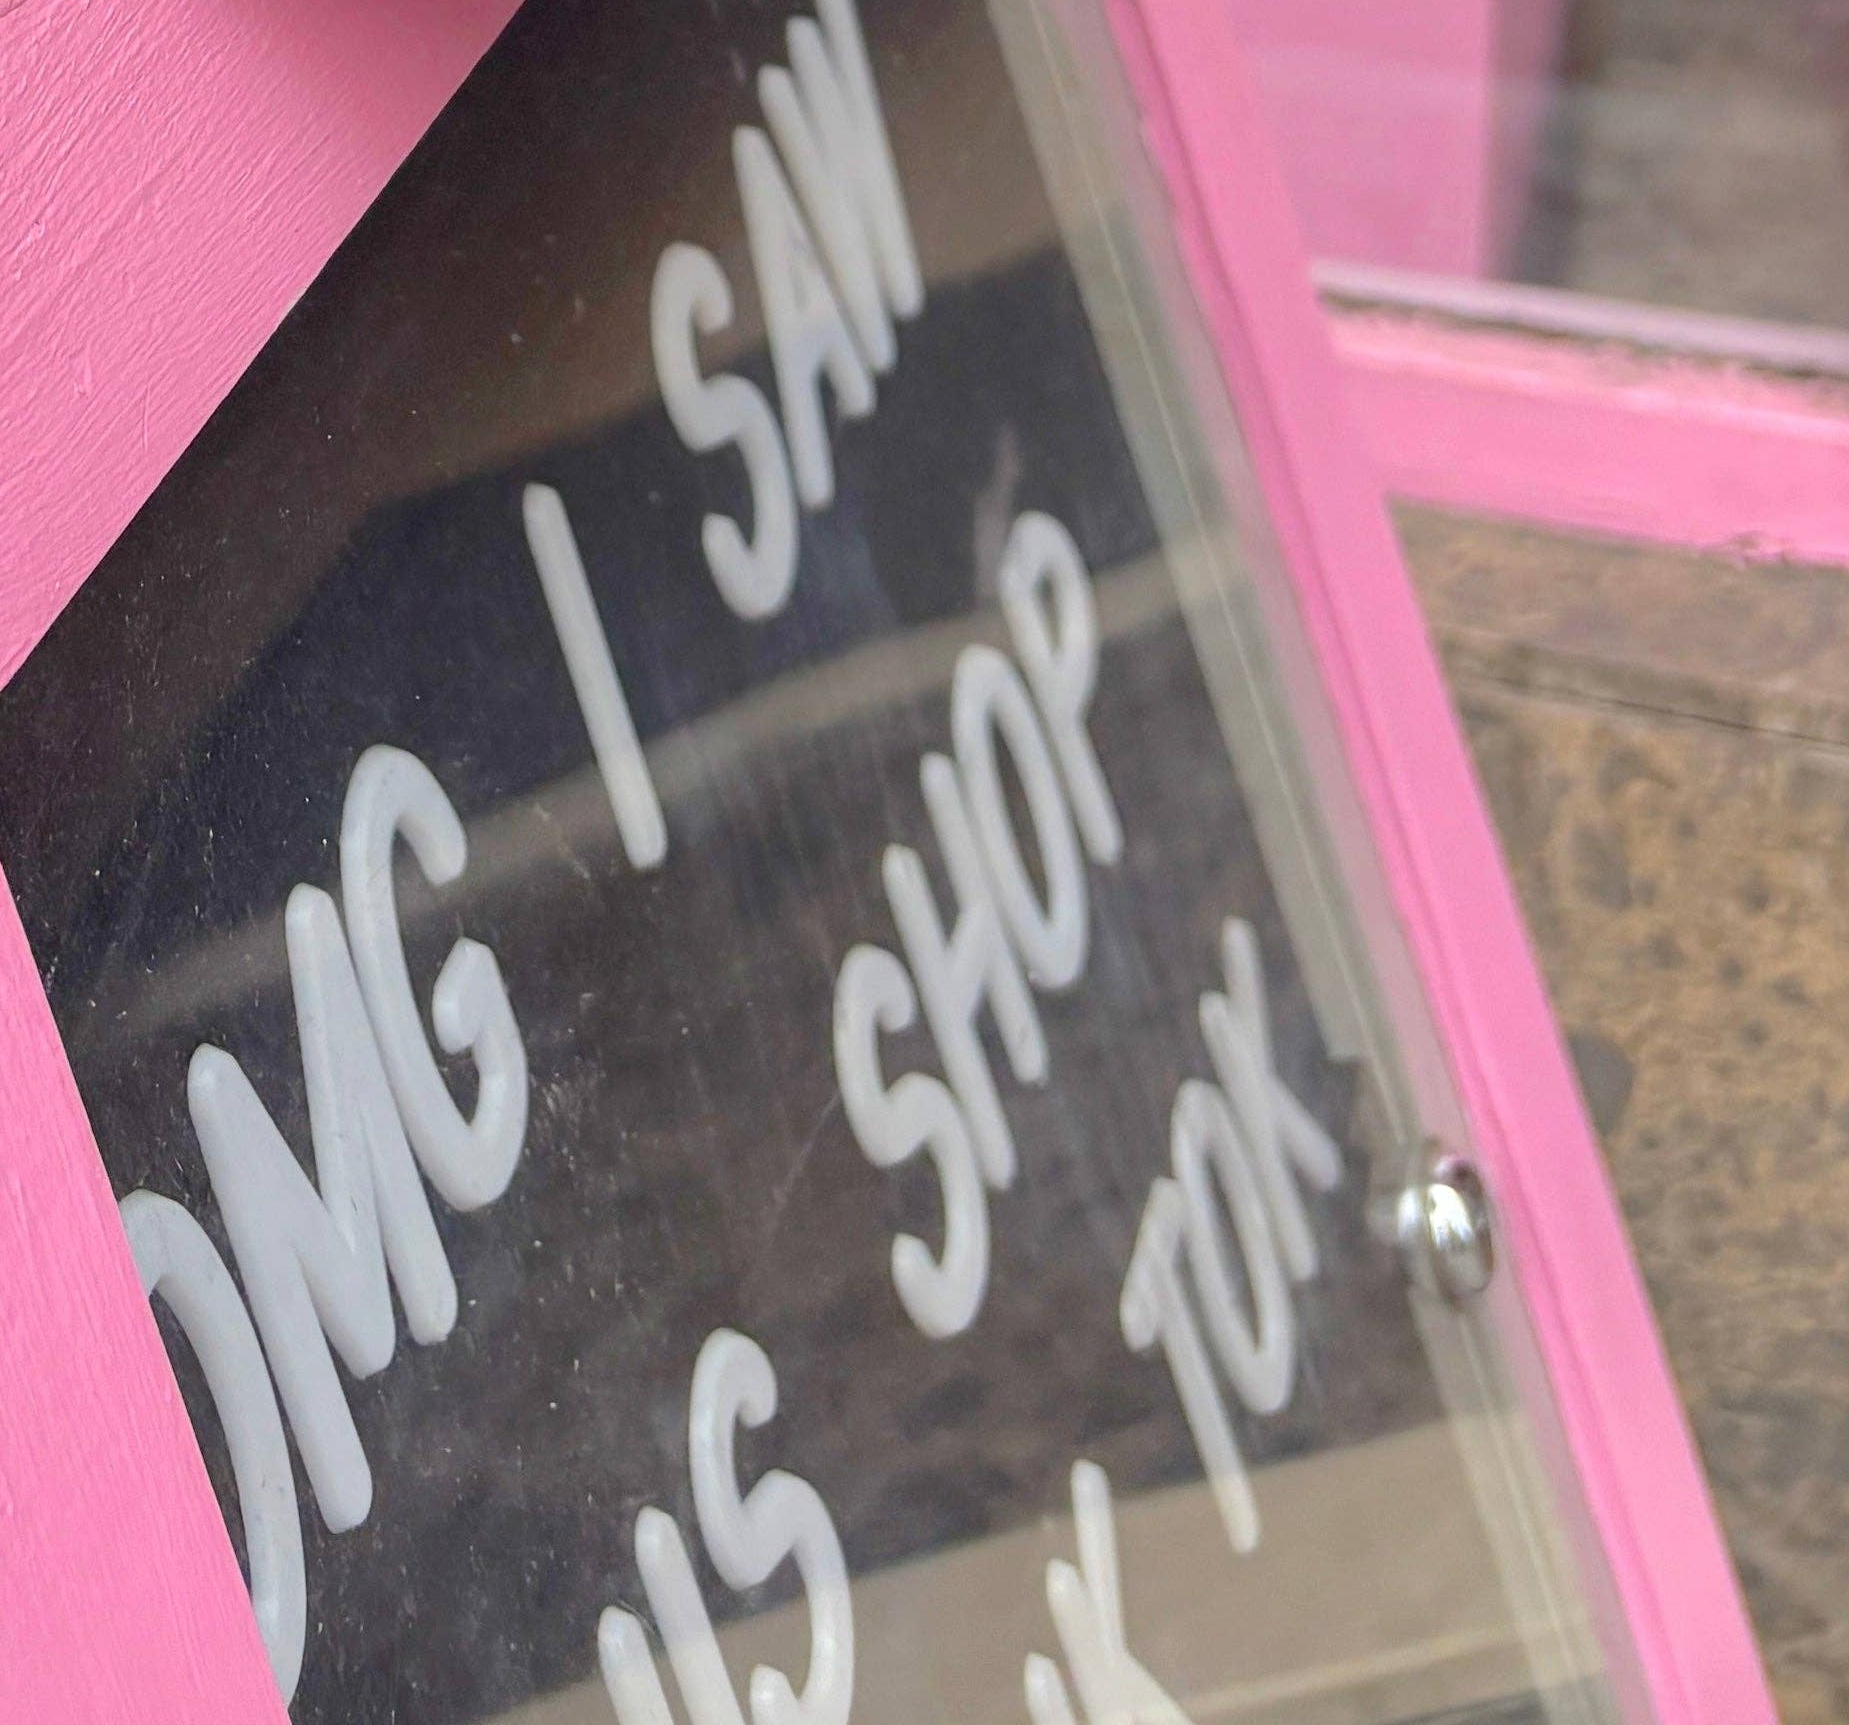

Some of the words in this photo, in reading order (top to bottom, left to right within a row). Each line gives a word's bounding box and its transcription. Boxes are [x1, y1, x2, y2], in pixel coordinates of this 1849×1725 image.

[522, 481, 669, 870] I
[832, 509, 1124, 1340] SHOP
[1119, 914, 1343, 1552] TOK
